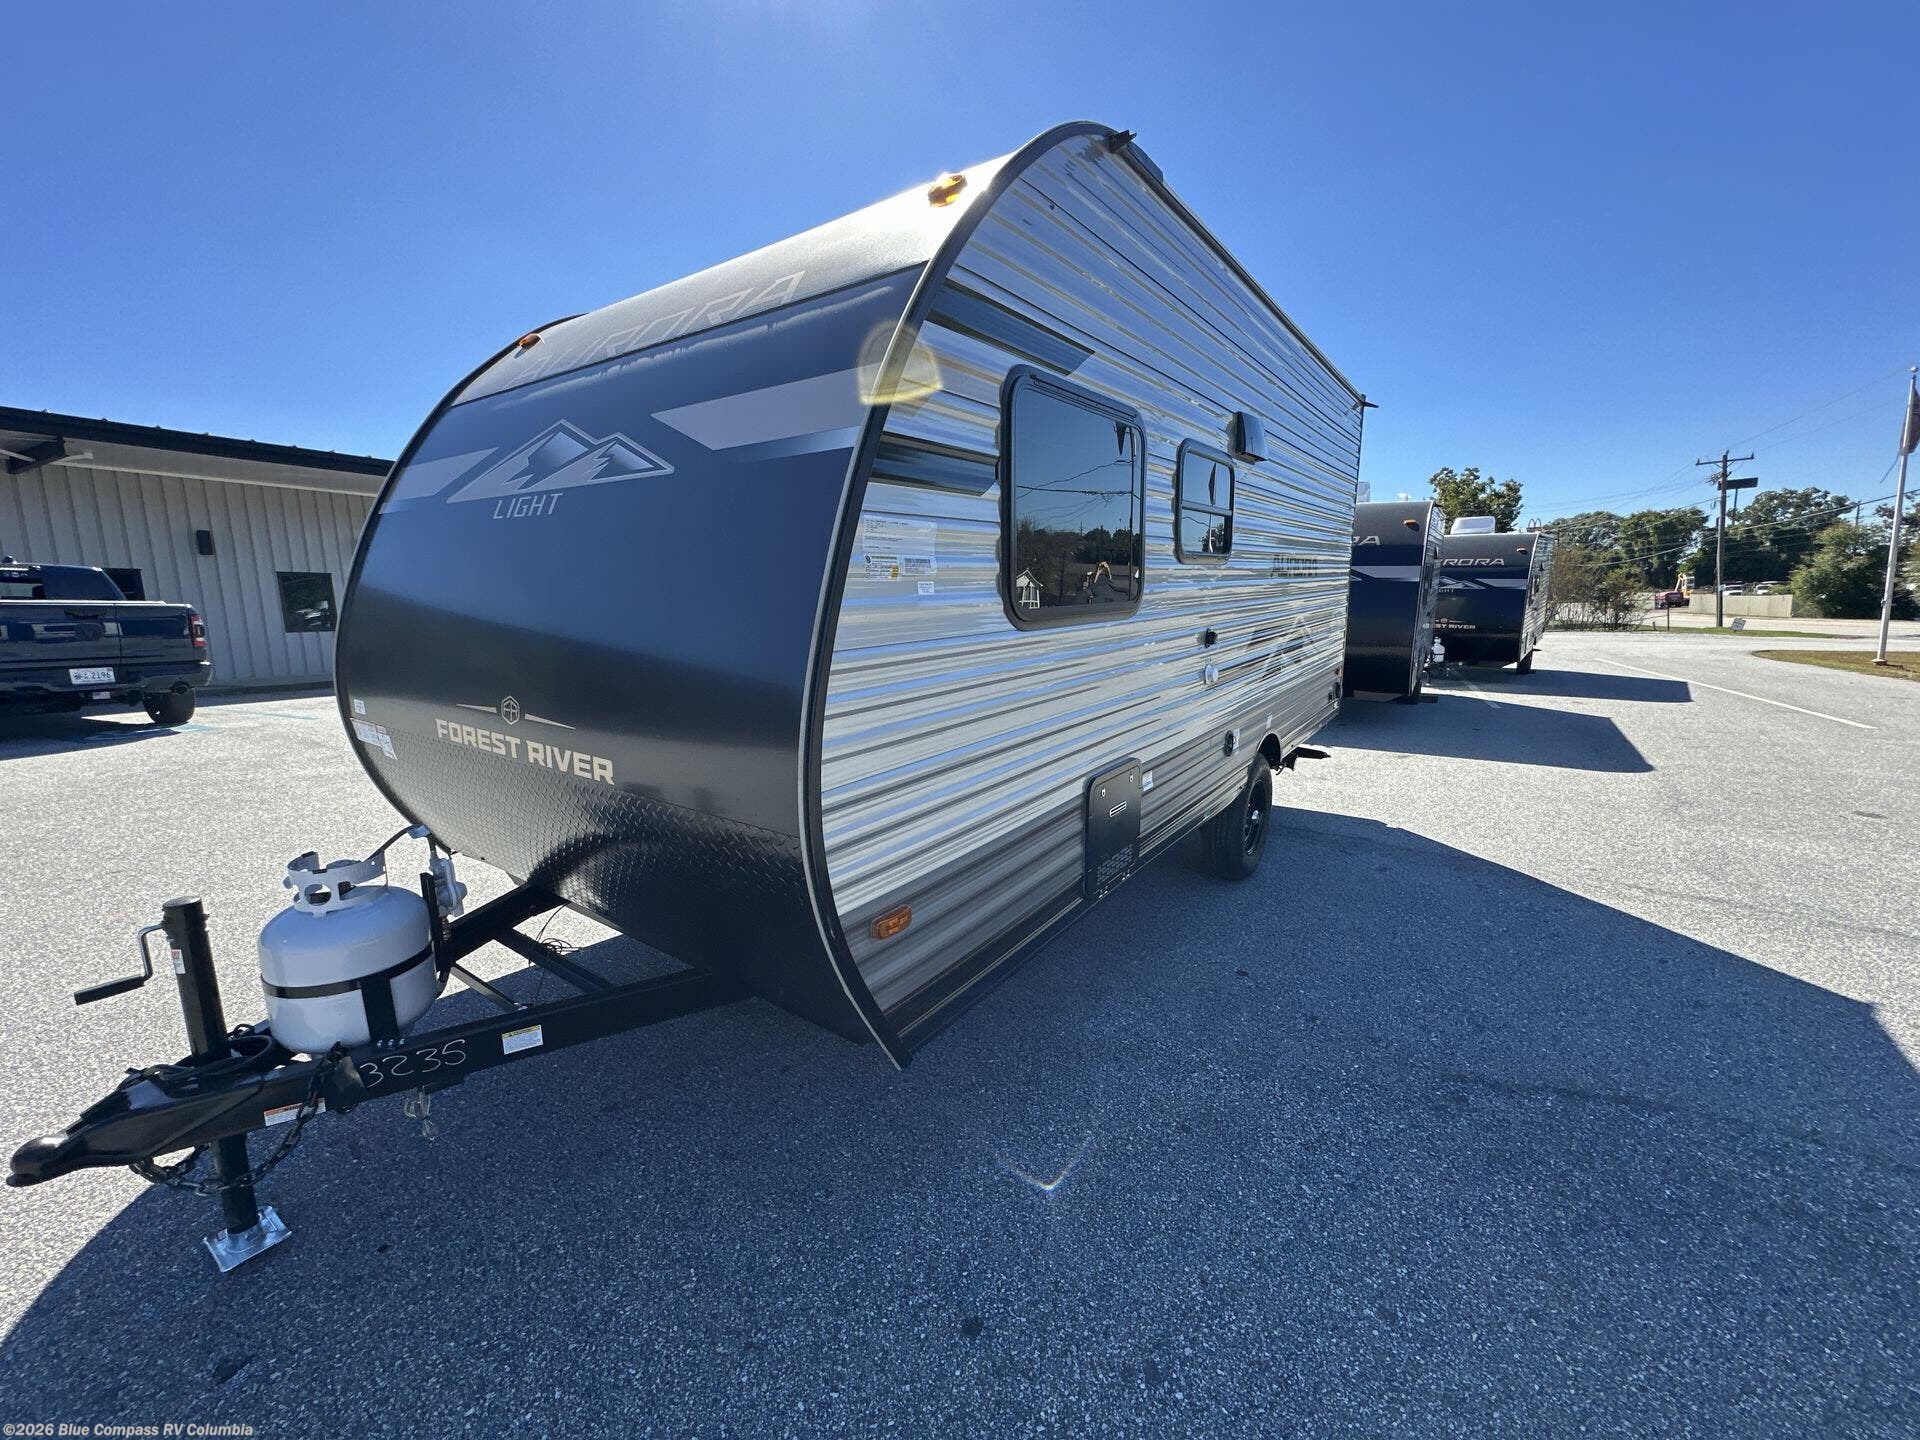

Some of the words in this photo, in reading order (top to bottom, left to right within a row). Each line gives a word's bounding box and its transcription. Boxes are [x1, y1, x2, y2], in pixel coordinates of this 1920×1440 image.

[492, 492, 564, 520] LIGHT
[1441, 558, 1505, 566] RORA
[434, 718, 522, 760] FOREST
[524, 739, 615, 786] RIVER
[359, 1038, 467, 1089] 3235
